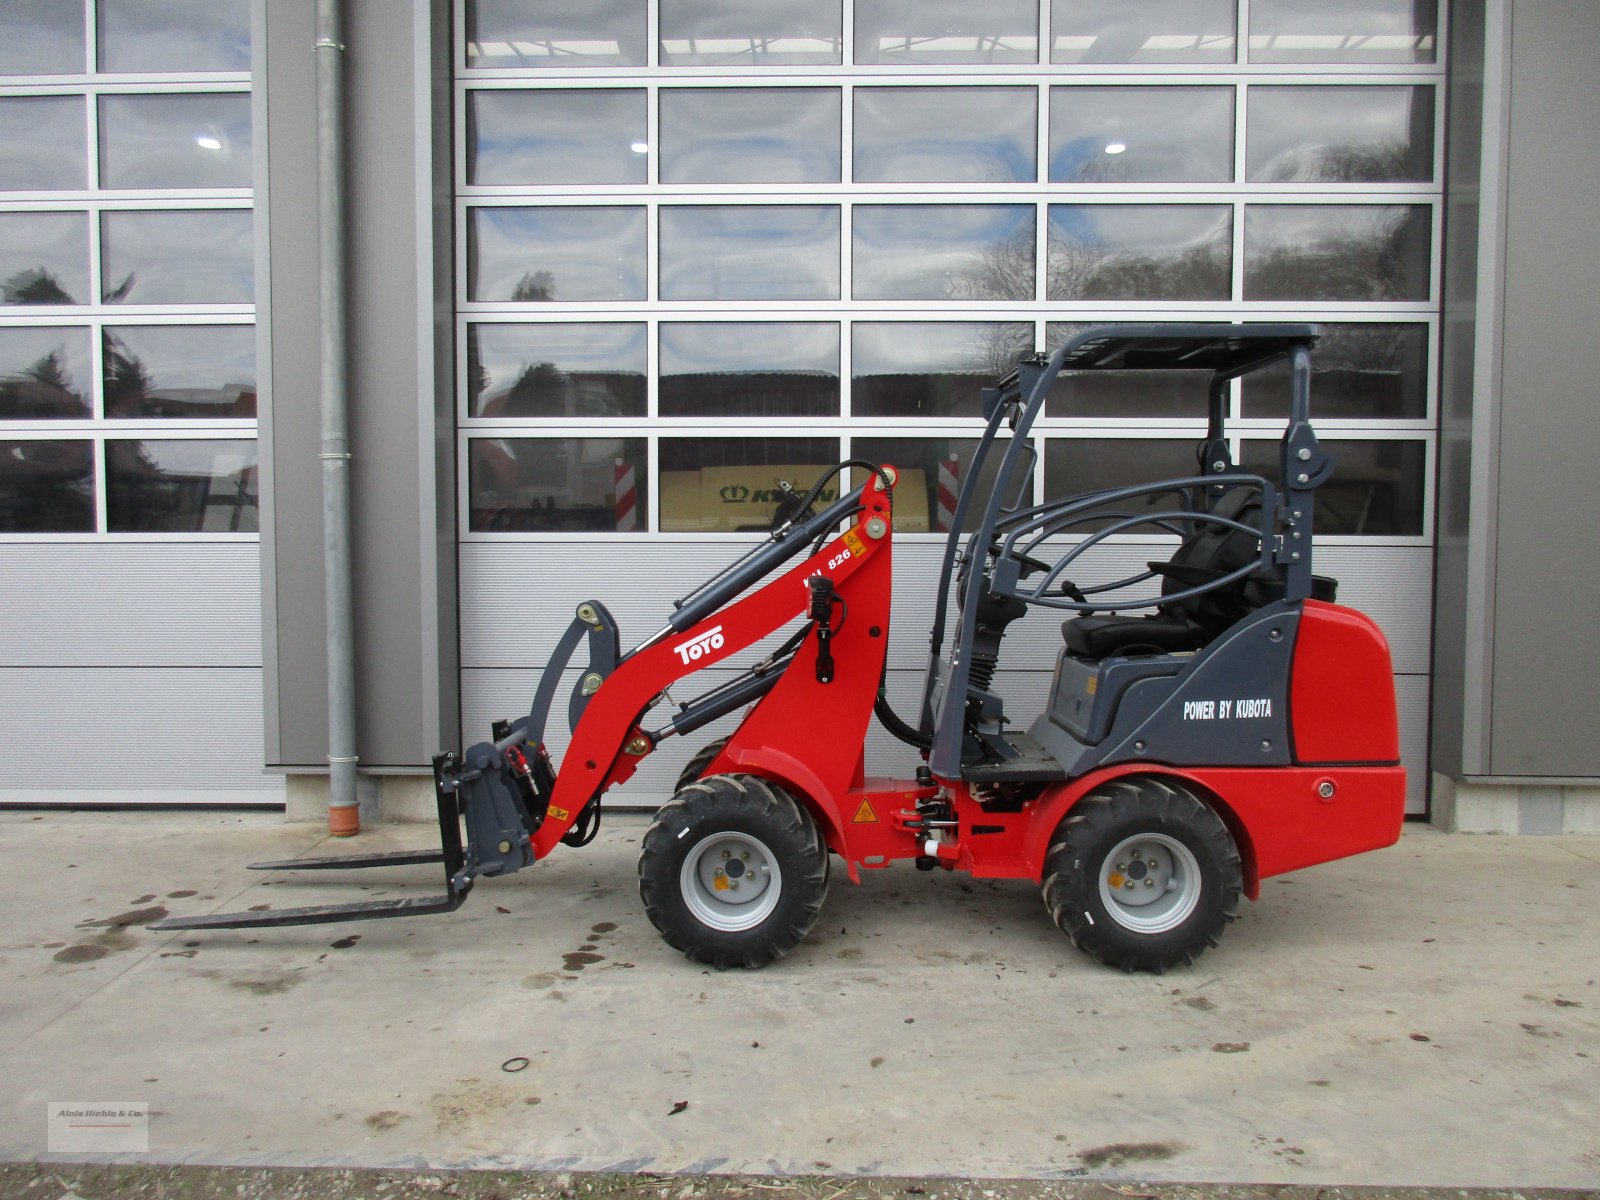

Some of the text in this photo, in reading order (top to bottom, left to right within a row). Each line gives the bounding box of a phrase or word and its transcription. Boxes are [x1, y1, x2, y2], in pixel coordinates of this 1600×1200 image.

[828, 549, 851, 570] 826
[673, 624, 725, 665] TOYO
[1183, 699, 1272, 720] POWER BY KUBOTA
